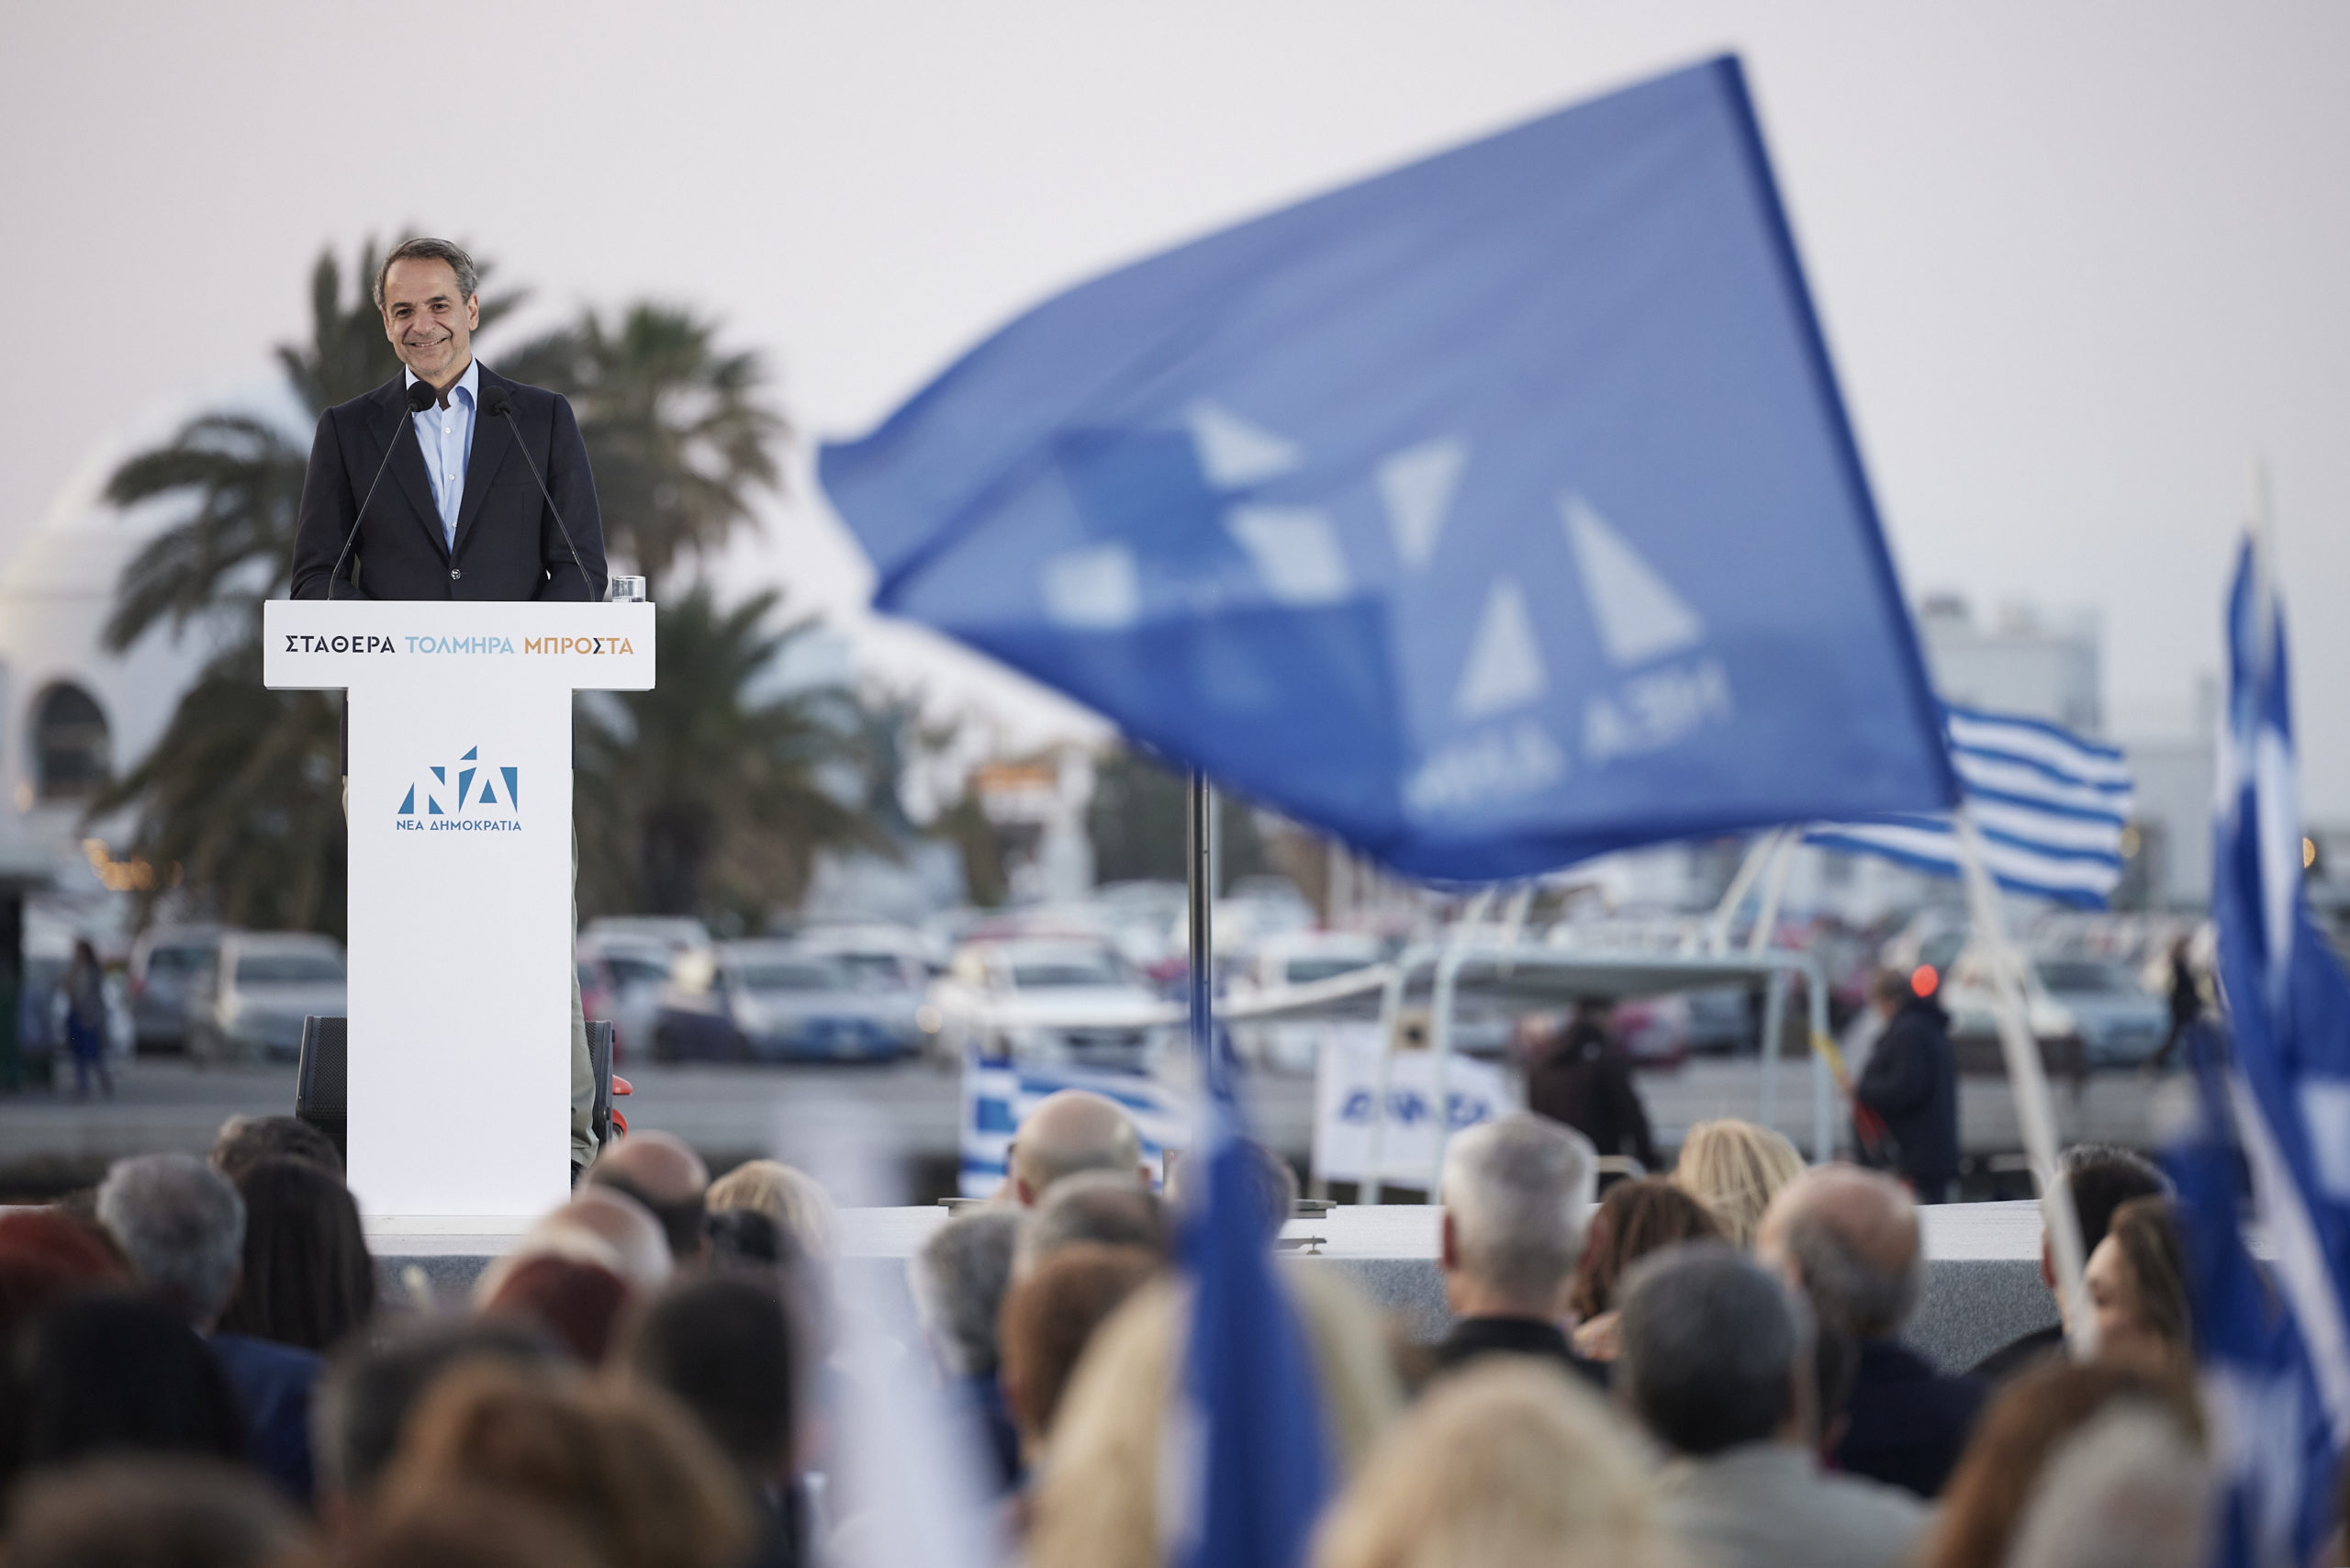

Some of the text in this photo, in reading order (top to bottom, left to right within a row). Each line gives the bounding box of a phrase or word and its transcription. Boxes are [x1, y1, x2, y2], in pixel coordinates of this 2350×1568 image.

[285, 634, 634, 655] ΣΤΑΘΕΡΑ ΤΟΛΜΗΡΑ ΜΠΡΟΣΤΑ
[397, 820, 522, 832] ΝΕΑ ΔΗΜΟΚΡΑΤΙΑ
